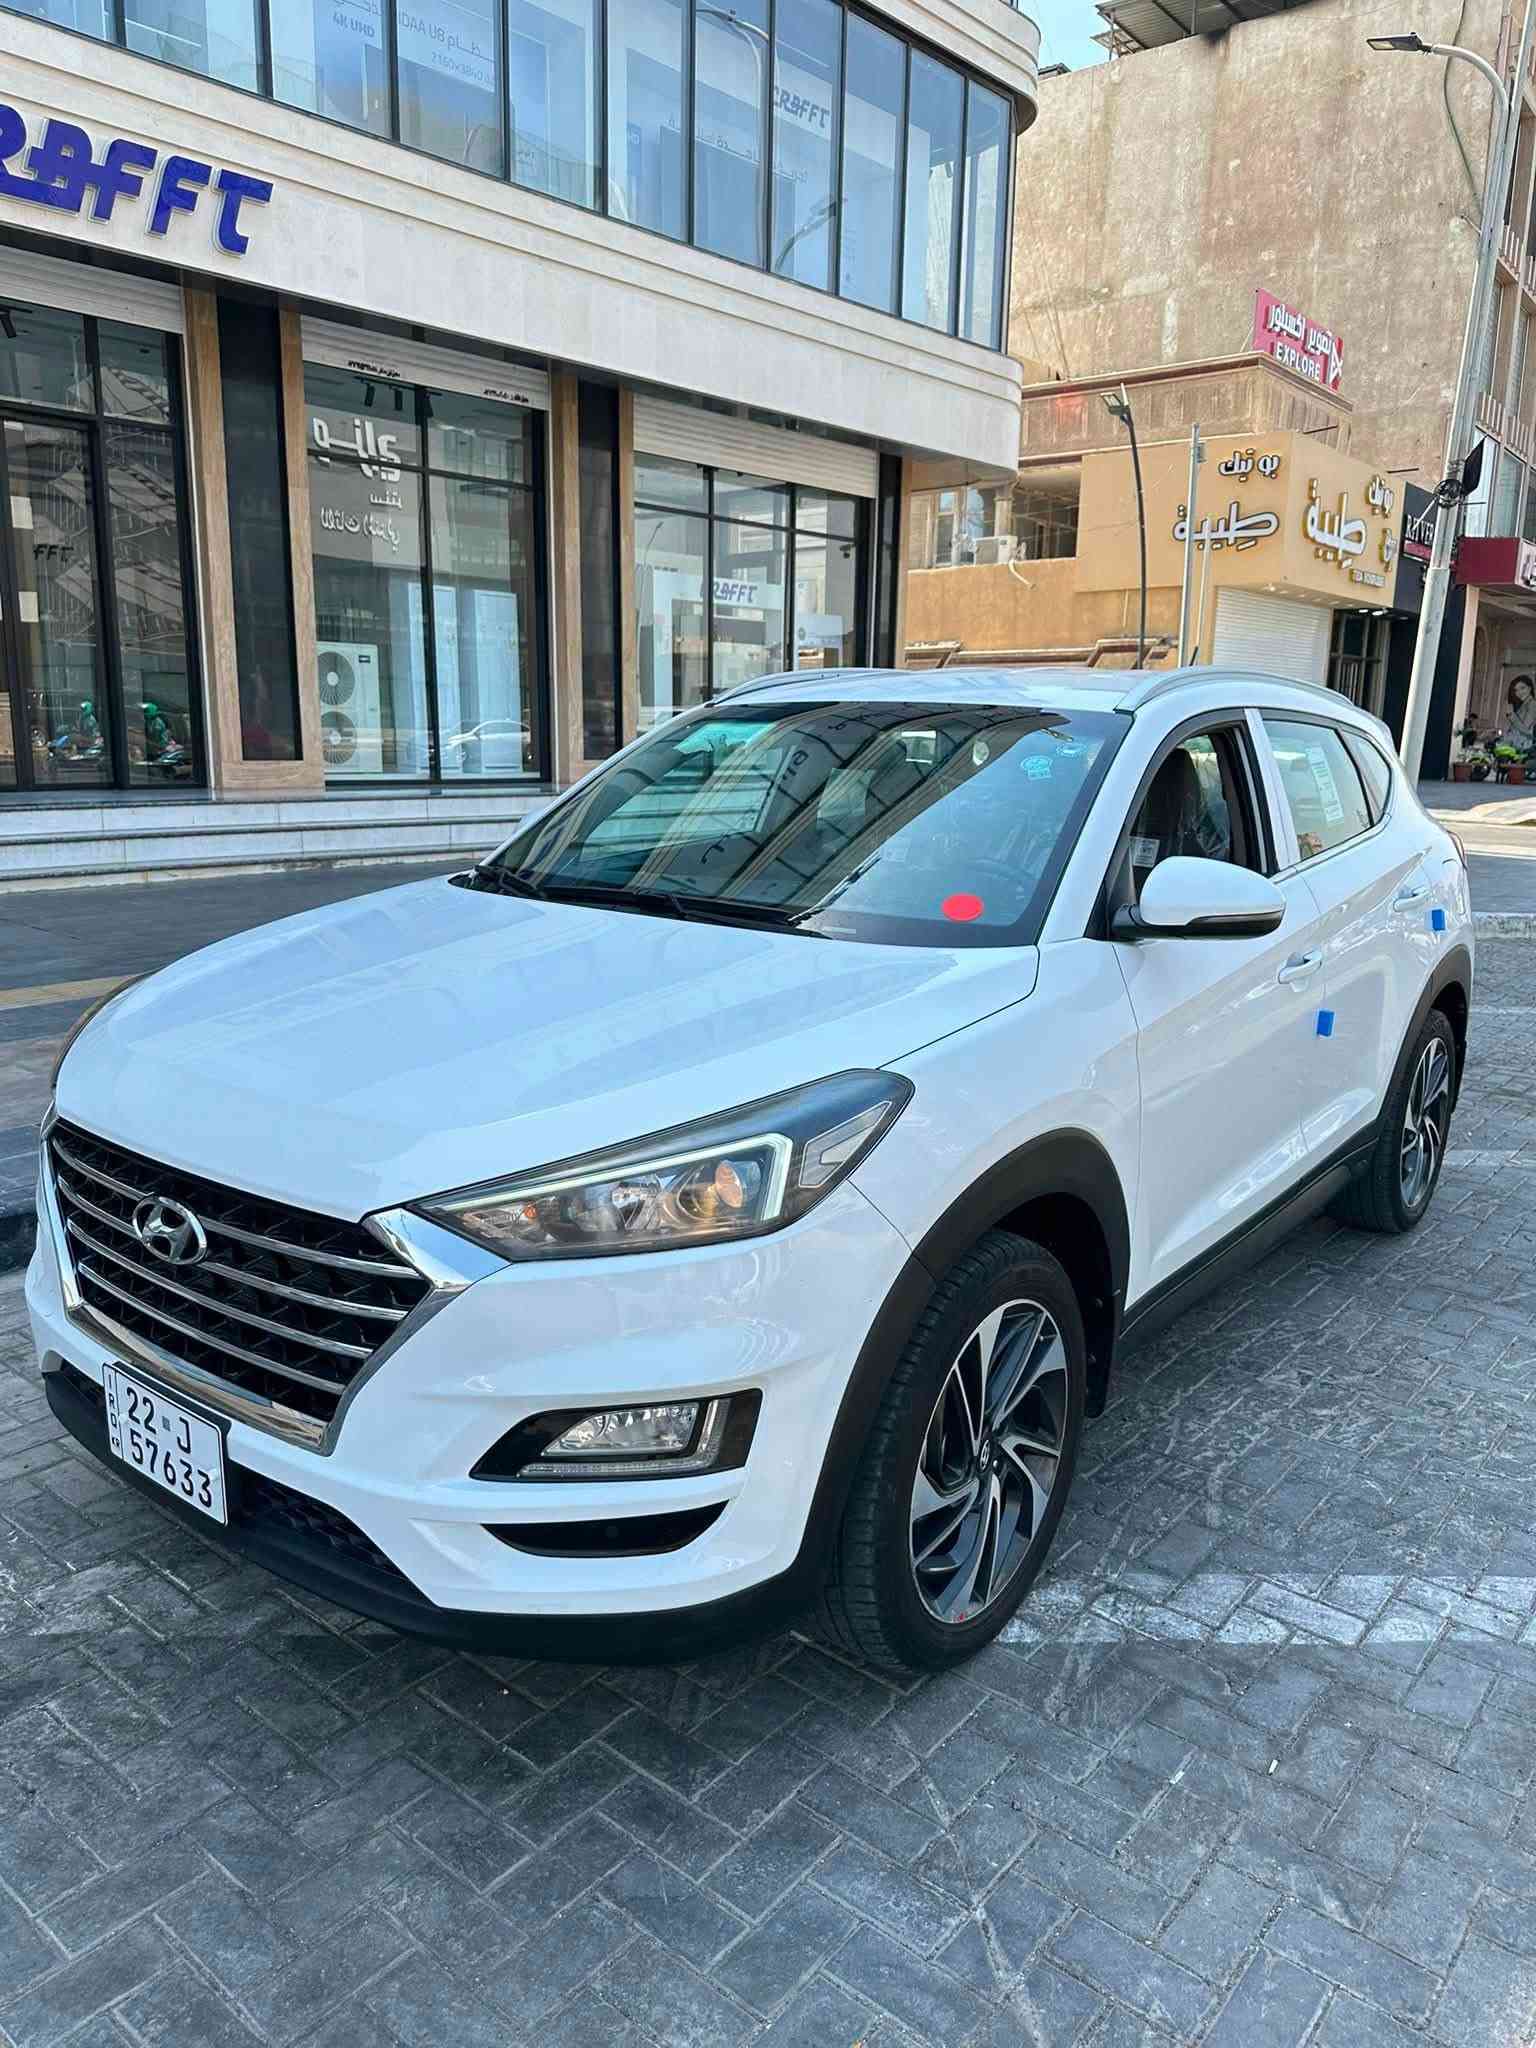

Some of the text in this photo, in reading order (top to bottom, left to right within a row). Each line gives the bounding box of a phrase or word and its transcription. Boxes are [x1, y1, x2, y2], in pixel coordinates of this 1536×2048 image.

[1276, 341, 1321, 381] EXPLORE
[127, 1386, 192, 1454] 22 J
[130, 1428, 212, 1508] 57633
